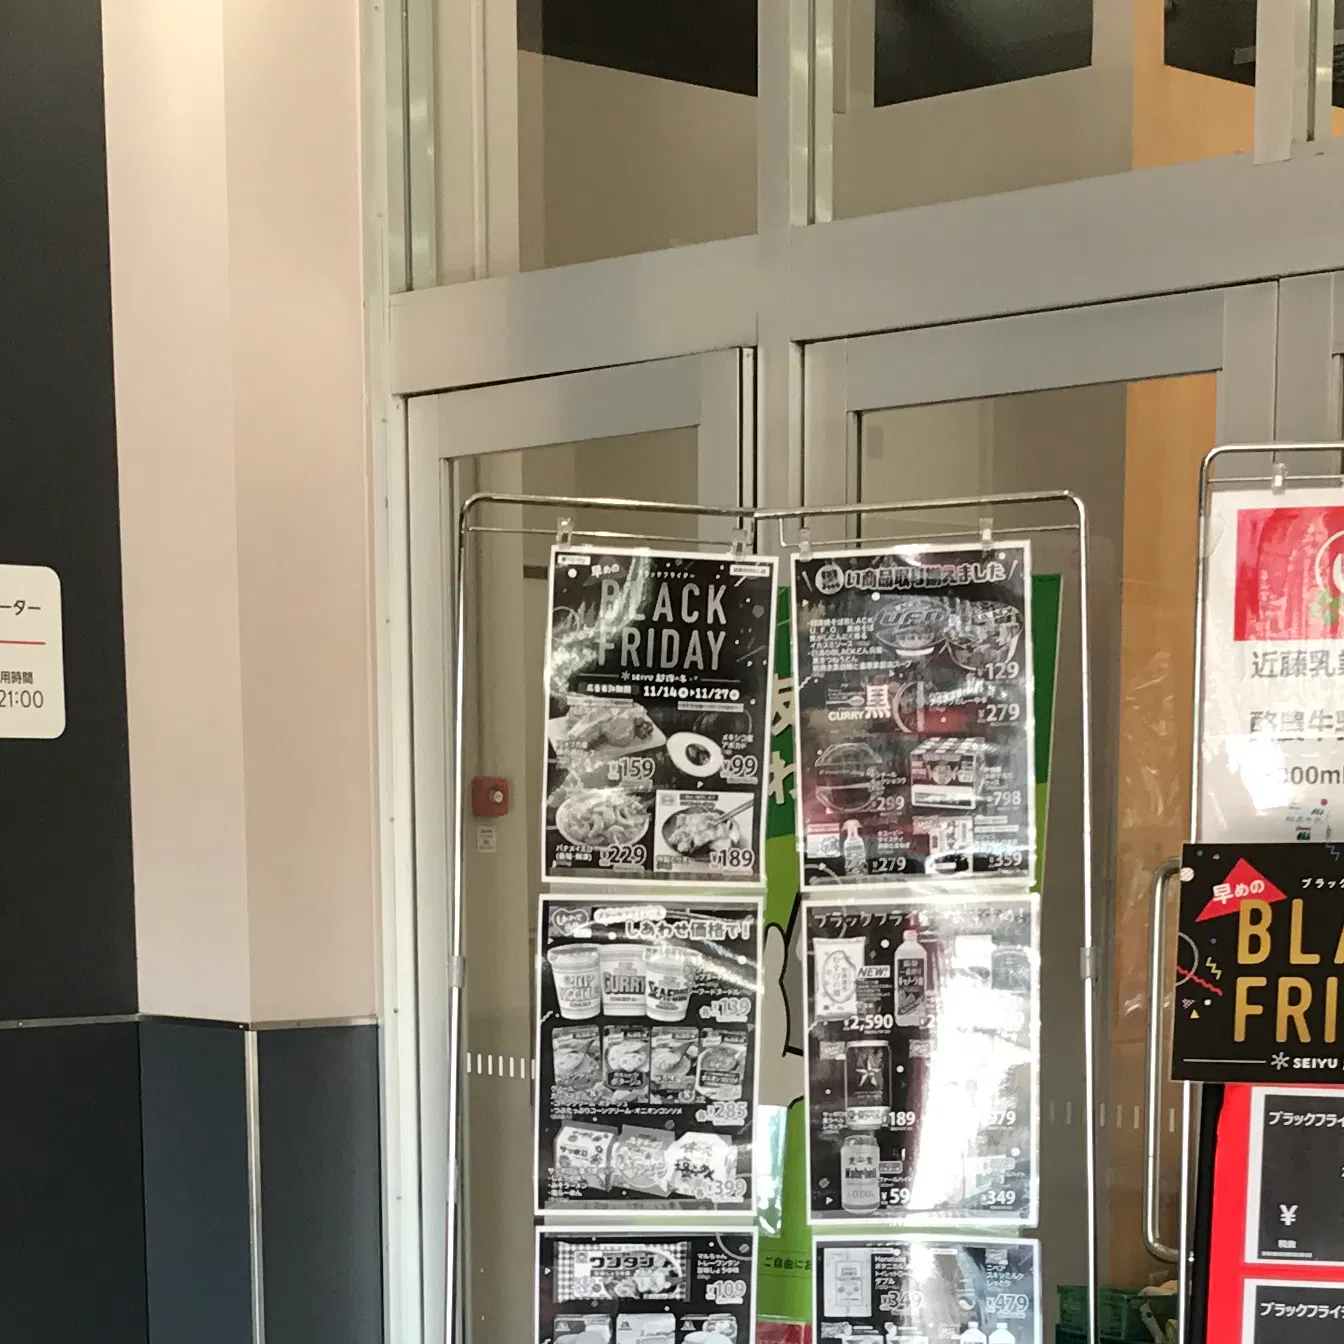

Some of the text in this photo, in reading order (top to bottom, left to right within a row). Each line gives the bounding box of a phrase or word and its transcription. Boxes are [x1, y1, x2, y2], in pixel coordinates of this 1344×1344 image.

[598, 627, 726, 670] FRIDAY
[1212, 878, 1265, 904] 早めの
[858, 967, 887, 976] NEW!
[1292, 1057, 1338, 1069] SEIYU
